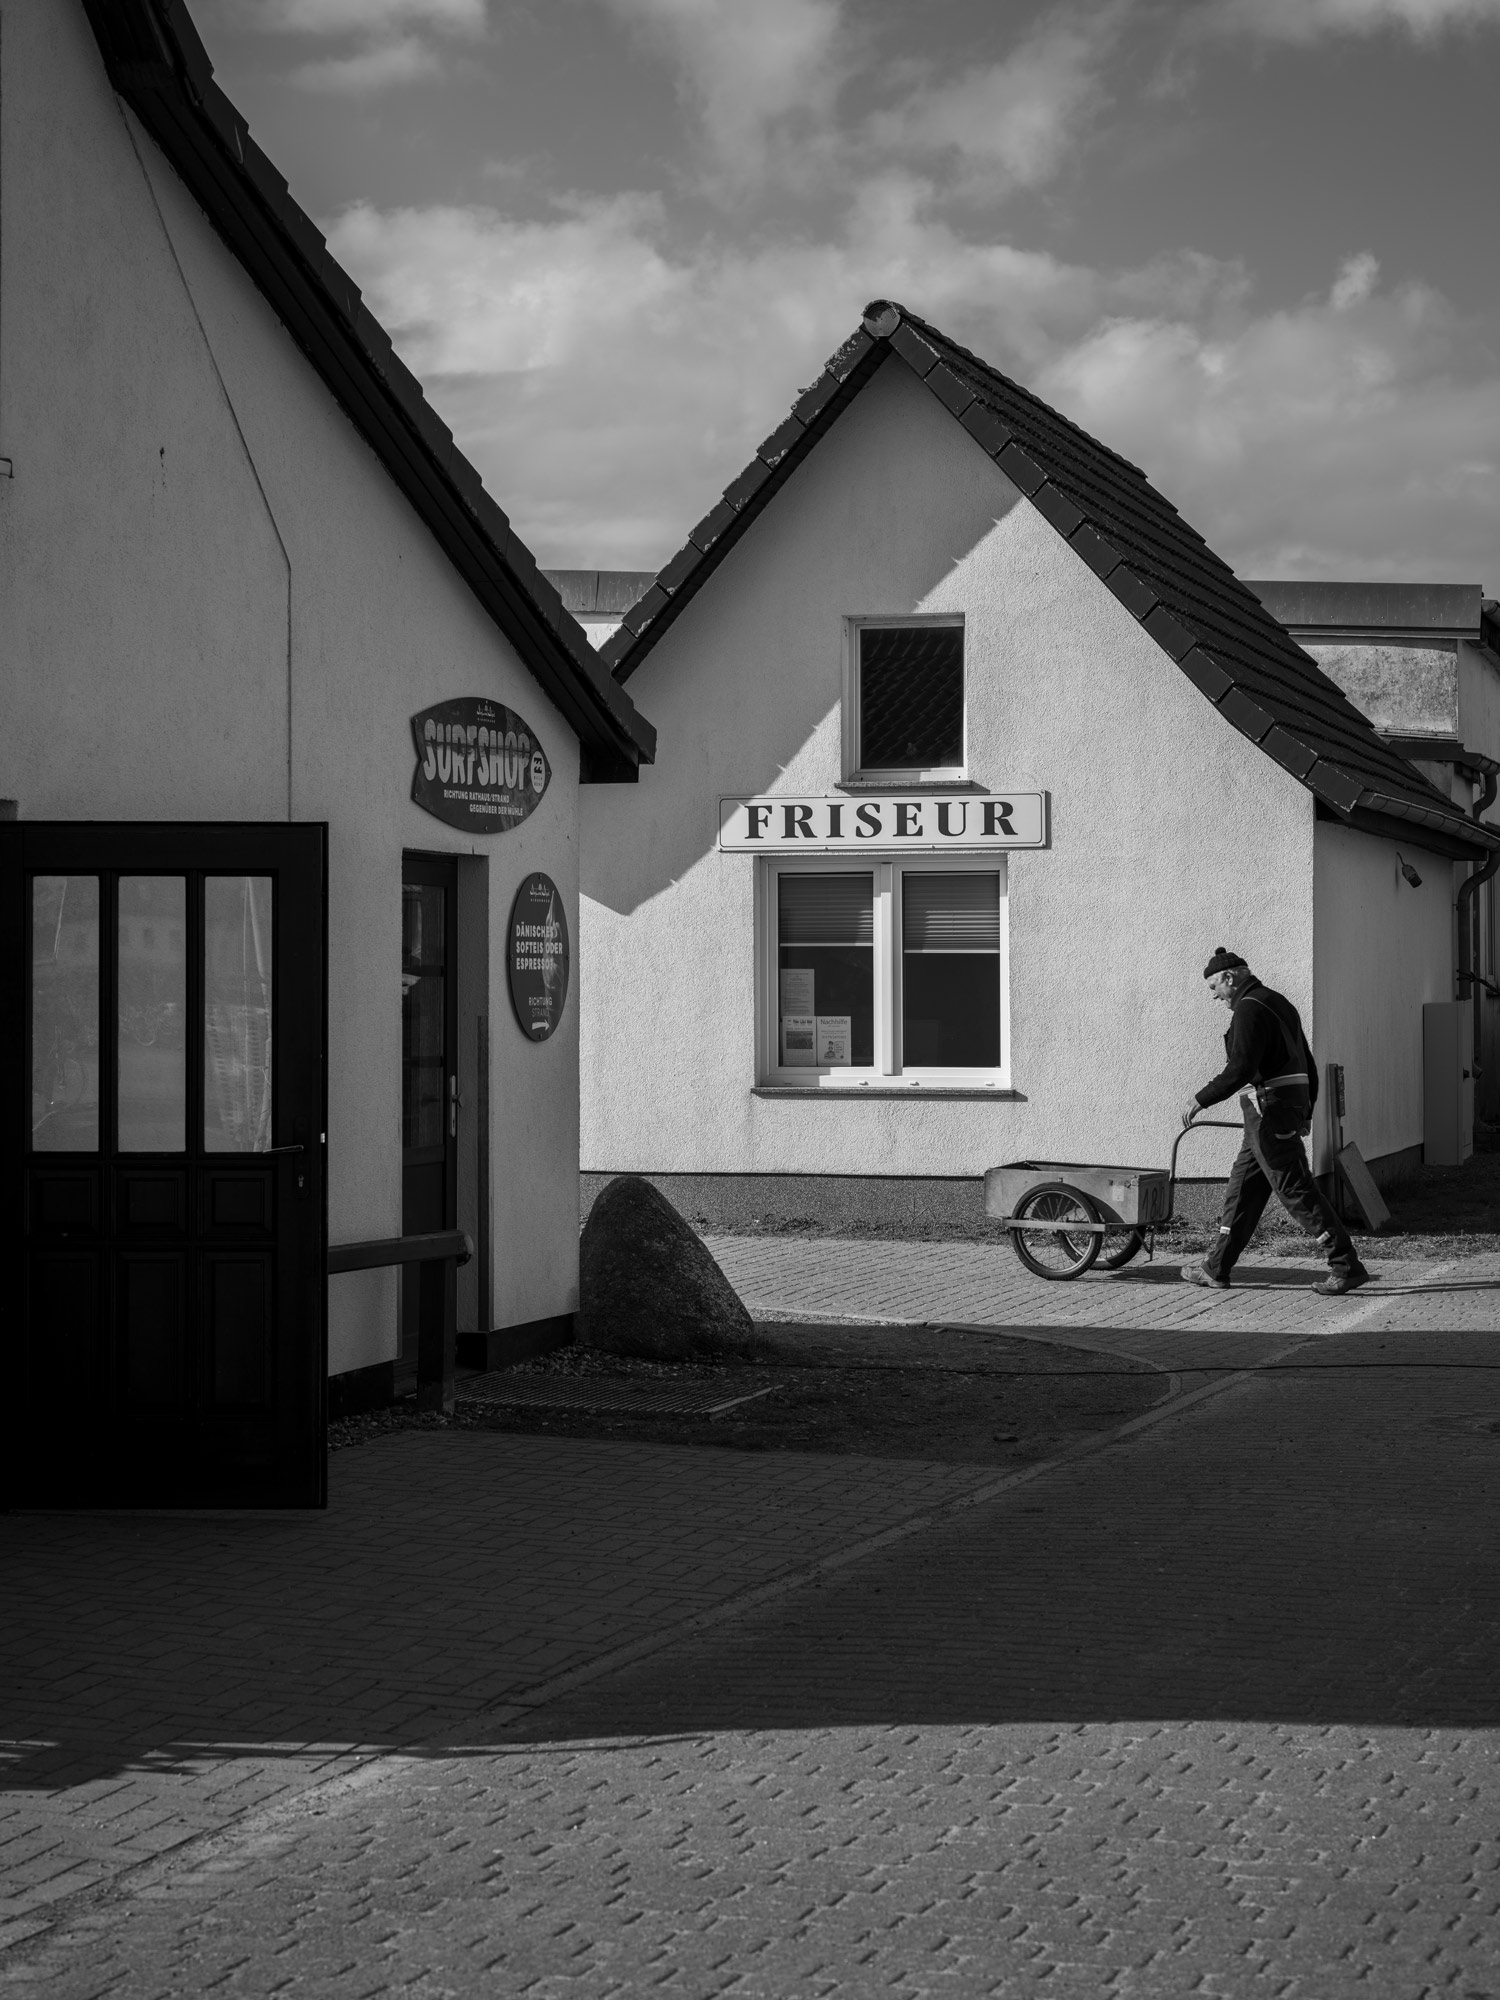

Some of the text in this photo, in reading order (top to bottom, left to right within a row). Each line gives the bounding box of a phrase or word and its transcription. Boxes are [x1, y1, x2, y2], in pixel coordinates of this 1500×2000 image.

[423, 718, 530, 791] SURFSHOP
[444, 789, 510, 803] RICHTUNG RATHAUS/STRAND
[469, 802, 523, 816] GEGENÜBER DER MÜHLE
[744, 801, 1018, 839] FRISEUR
[516, 921, 554, 938] DÄNISCHES
[516, 941, 563, 954] SOFTEIS ODER
[516, 957, 554, 970] ESPRESSO?
[528, 996, 553, 1006] RICHTUNG
